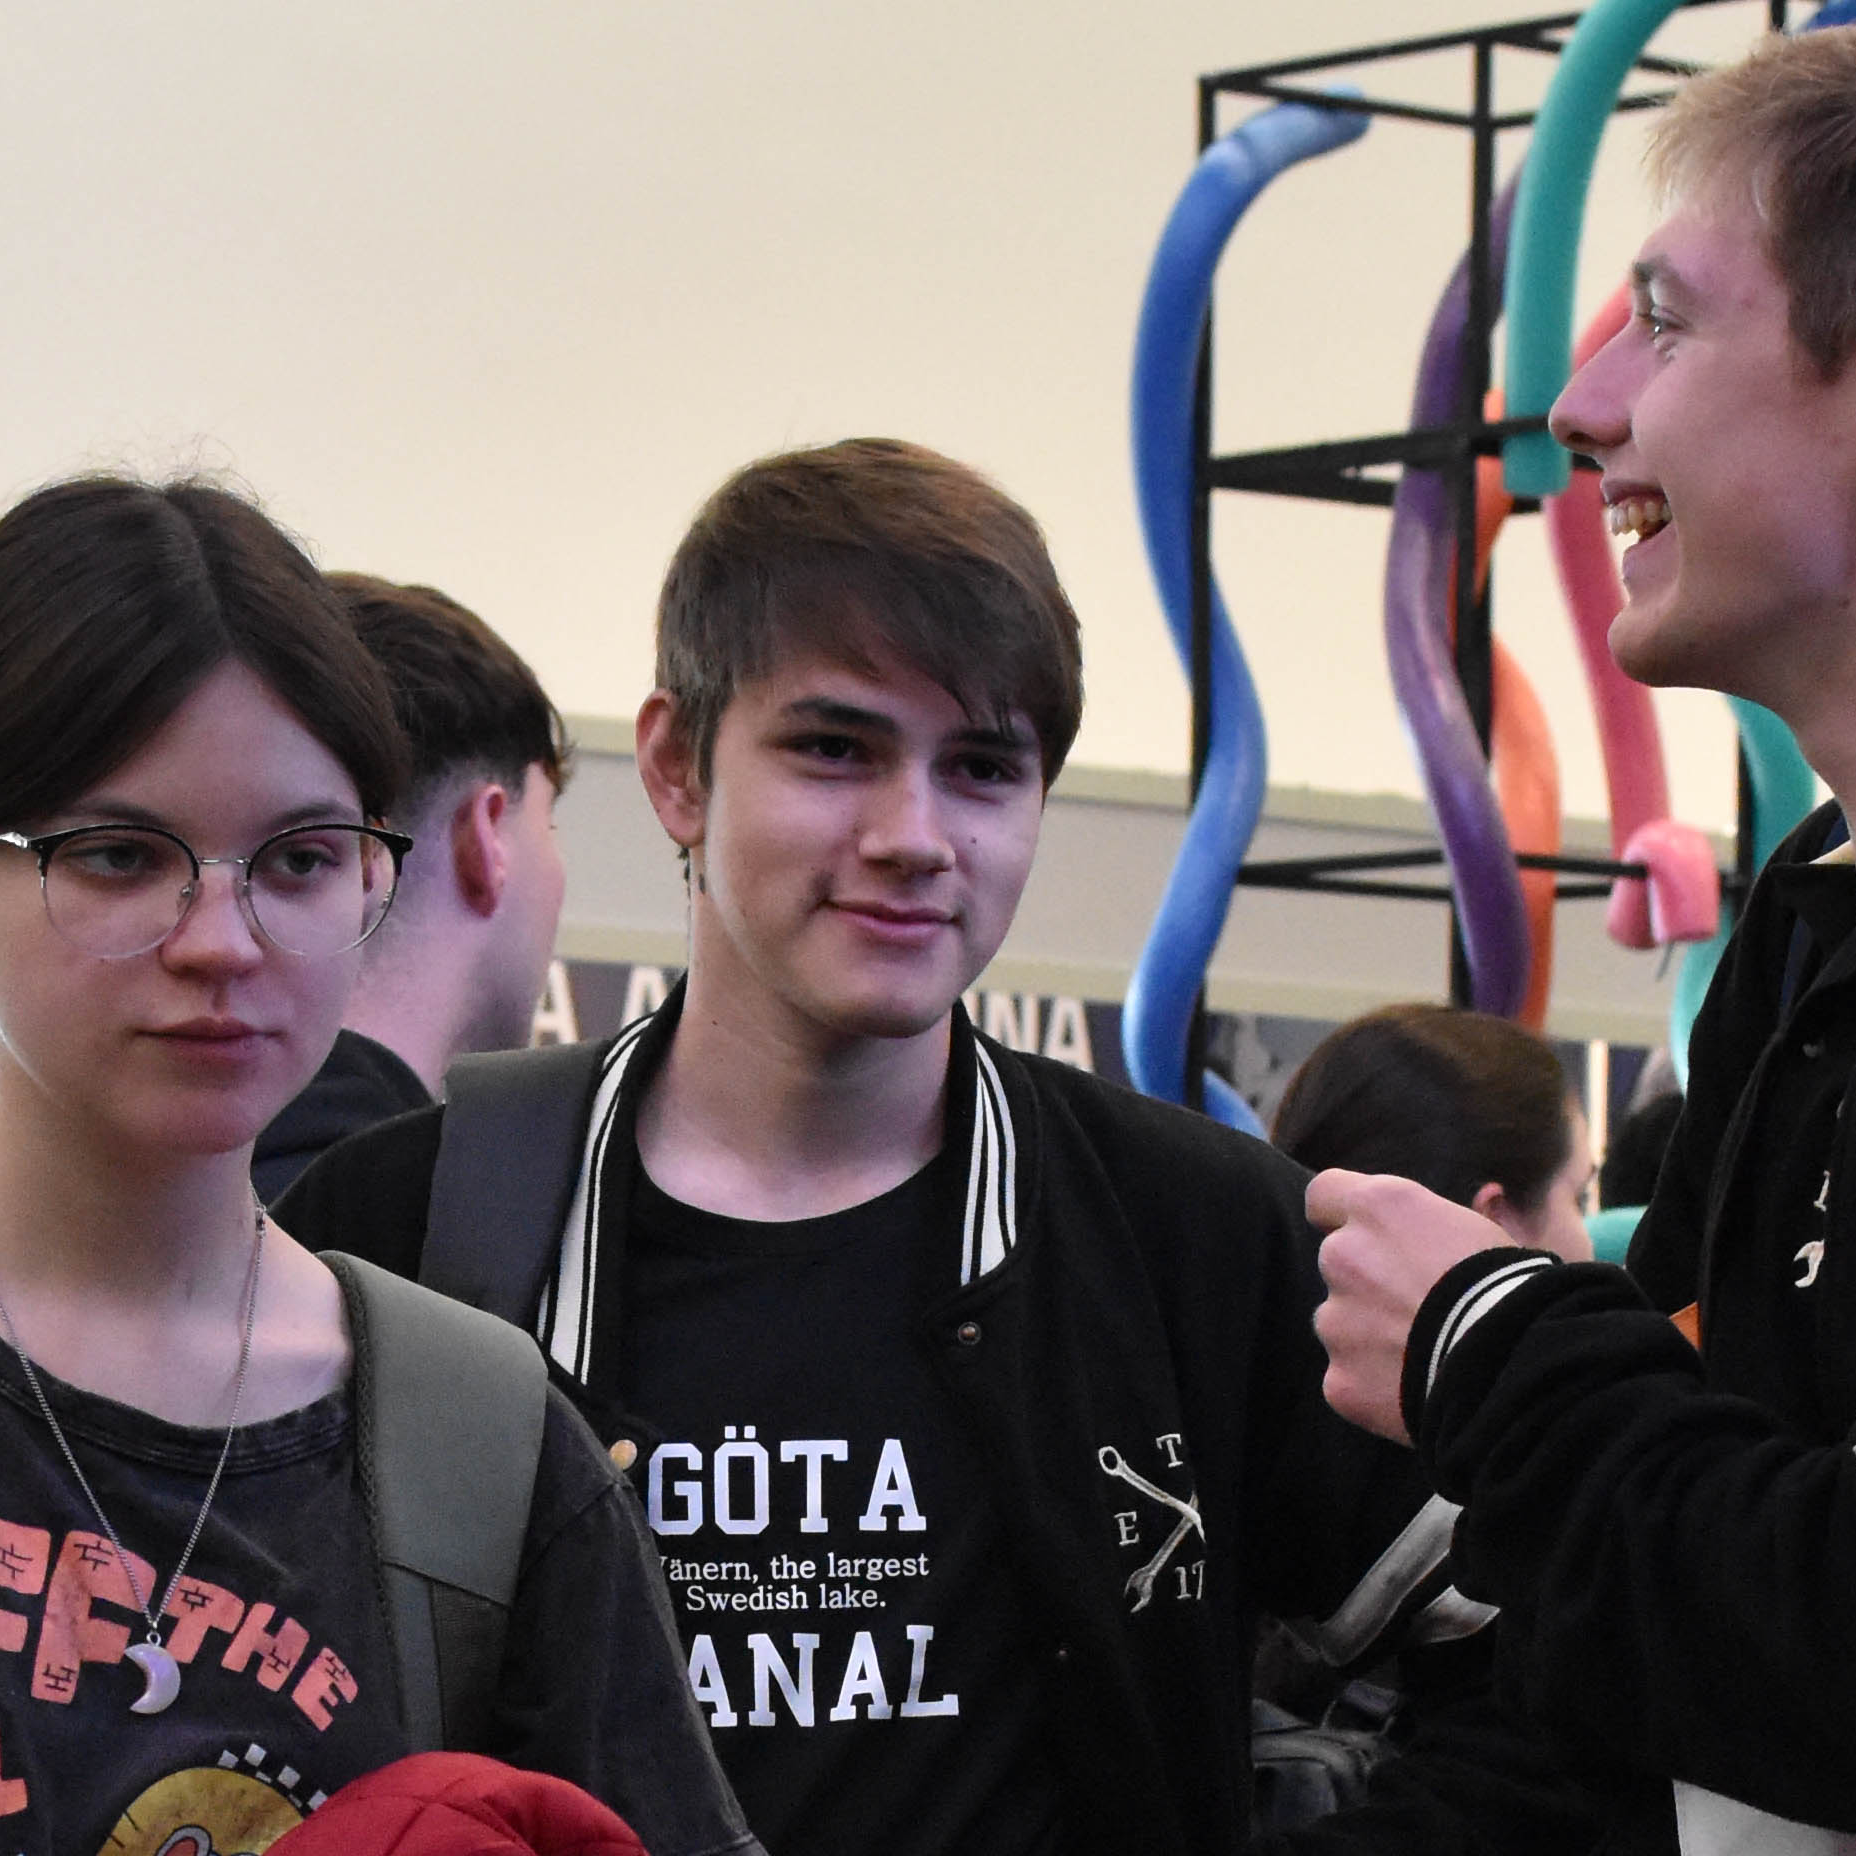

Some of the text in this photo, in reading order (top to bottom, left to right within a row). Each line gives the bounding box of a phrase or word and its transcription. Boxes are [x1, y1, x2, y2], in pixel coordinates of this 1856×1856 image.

[648, 1426, 926, 1535] GÖTA
[686, 1582, 887, 1612] Swedish lake.
[770, 1554, 817, 1581] the
[827, 1552, 930, 1582] largest
[162, 1574, 359, 1731] THE
[687, 1624, 959, 1728] ANAL
